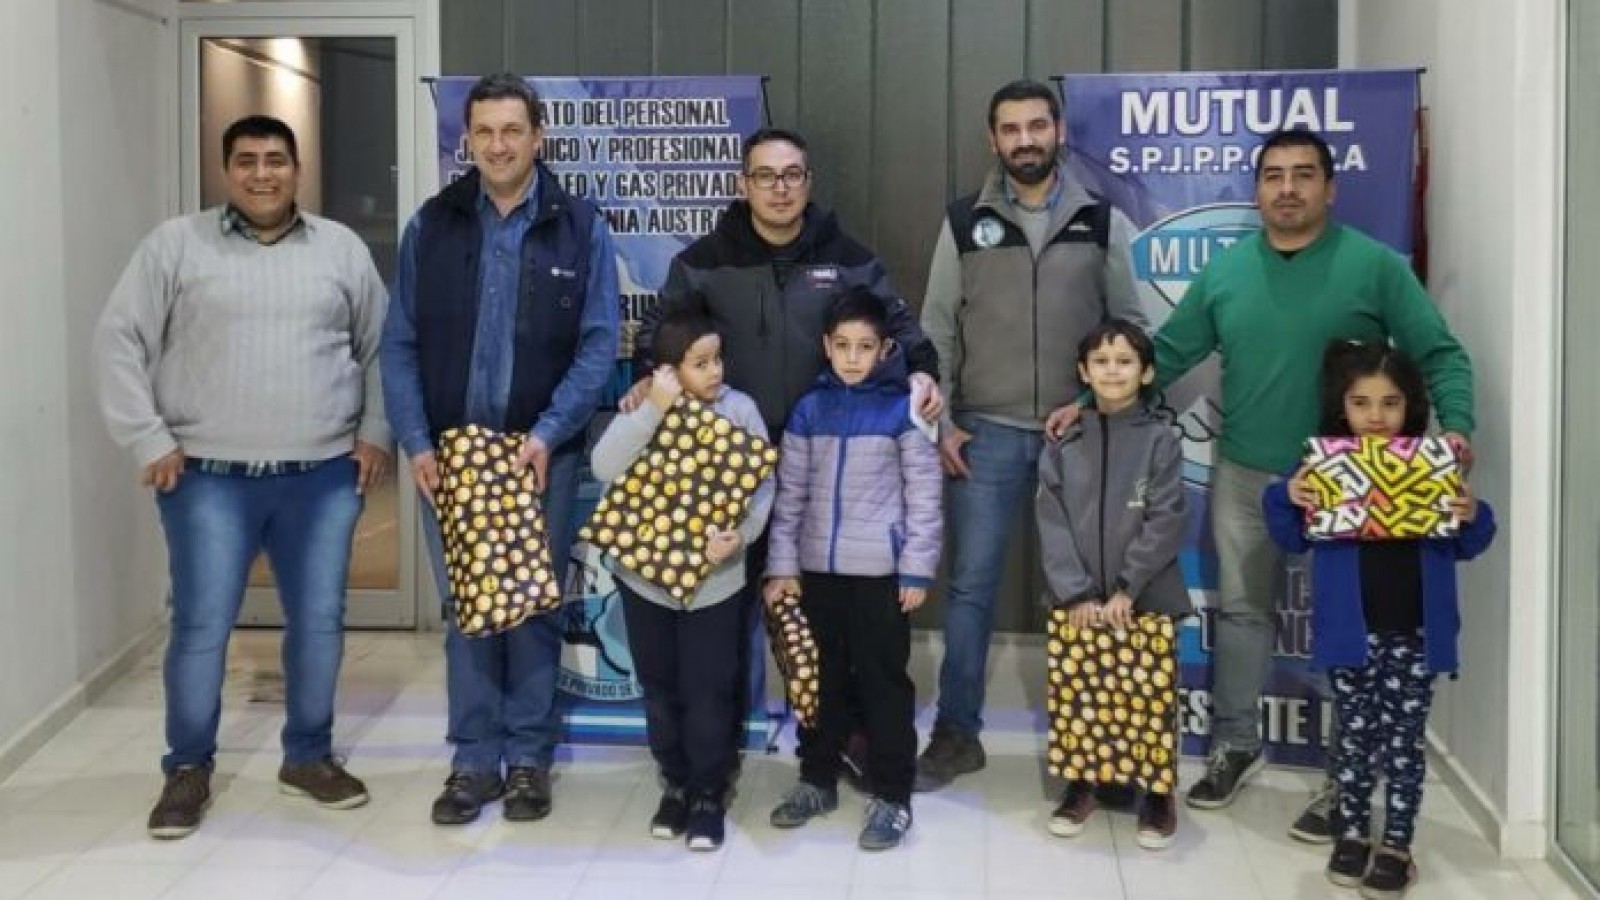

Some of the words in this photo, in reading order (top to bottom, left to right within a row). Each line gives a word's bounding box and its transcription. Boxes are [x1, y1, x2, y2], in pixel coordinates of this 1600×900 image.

[540, 99, 576, 126] ATO
[582, 99, 618, 126] DEL
[623, 98, 730, 126] PERSONAL
[1121, 87, 1354, 134] MUTUAL
[588, 136, 601, 162] Y
[607, 134, 741, 162] PROFESIONAL
[593, 171, 608, 198] Y
[615, 171, 656, 198] GAS
[662, 170, 739, 198] PRIVAD
[648, 205, 721, 235] AUSTR
[1258, 695, 1309, 745] TE
